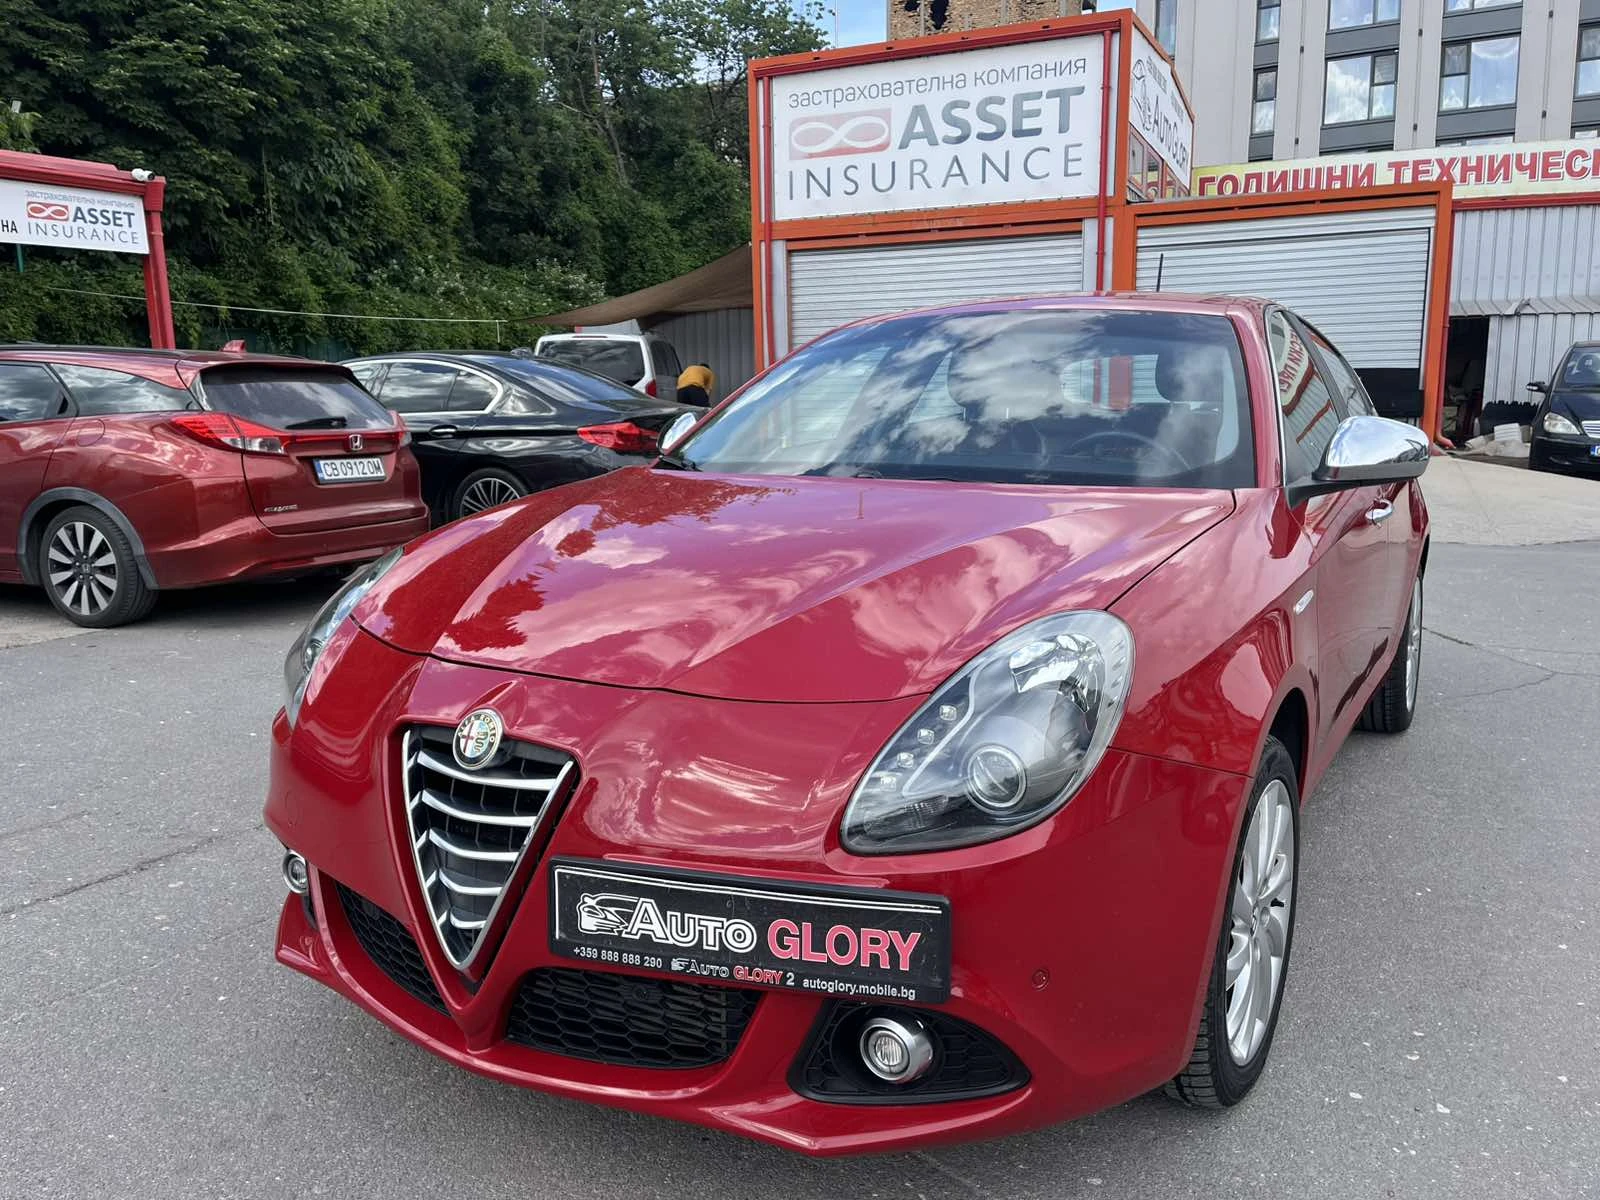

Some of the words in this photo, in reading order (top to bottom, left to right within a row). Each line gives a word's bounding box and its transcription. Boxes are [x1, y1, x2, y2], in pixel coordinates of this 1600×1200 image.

[788, 73, 967, 108] застрахователна
[974, 58, 1087, 86] компания
[897, 86, 1086, 150] ASSET
[788, 143, 1083, 200] INSURANCE
[72, 206, 135, 228] ASSET
[27, 222, 139, 244] INSURANCE
[767, 918, 921, 971] GLORY
[573, 946, 598, 959] +359
[601, 950, 619, 962] 888
[622, 953, 641, 966] 888
[643, 956, 663, 969] 290
[733, 965, 783, 985] GLORY
[786, 973, 795, 986] 2
[802, 977, 916, 1000] autoglory.mobile.bg
